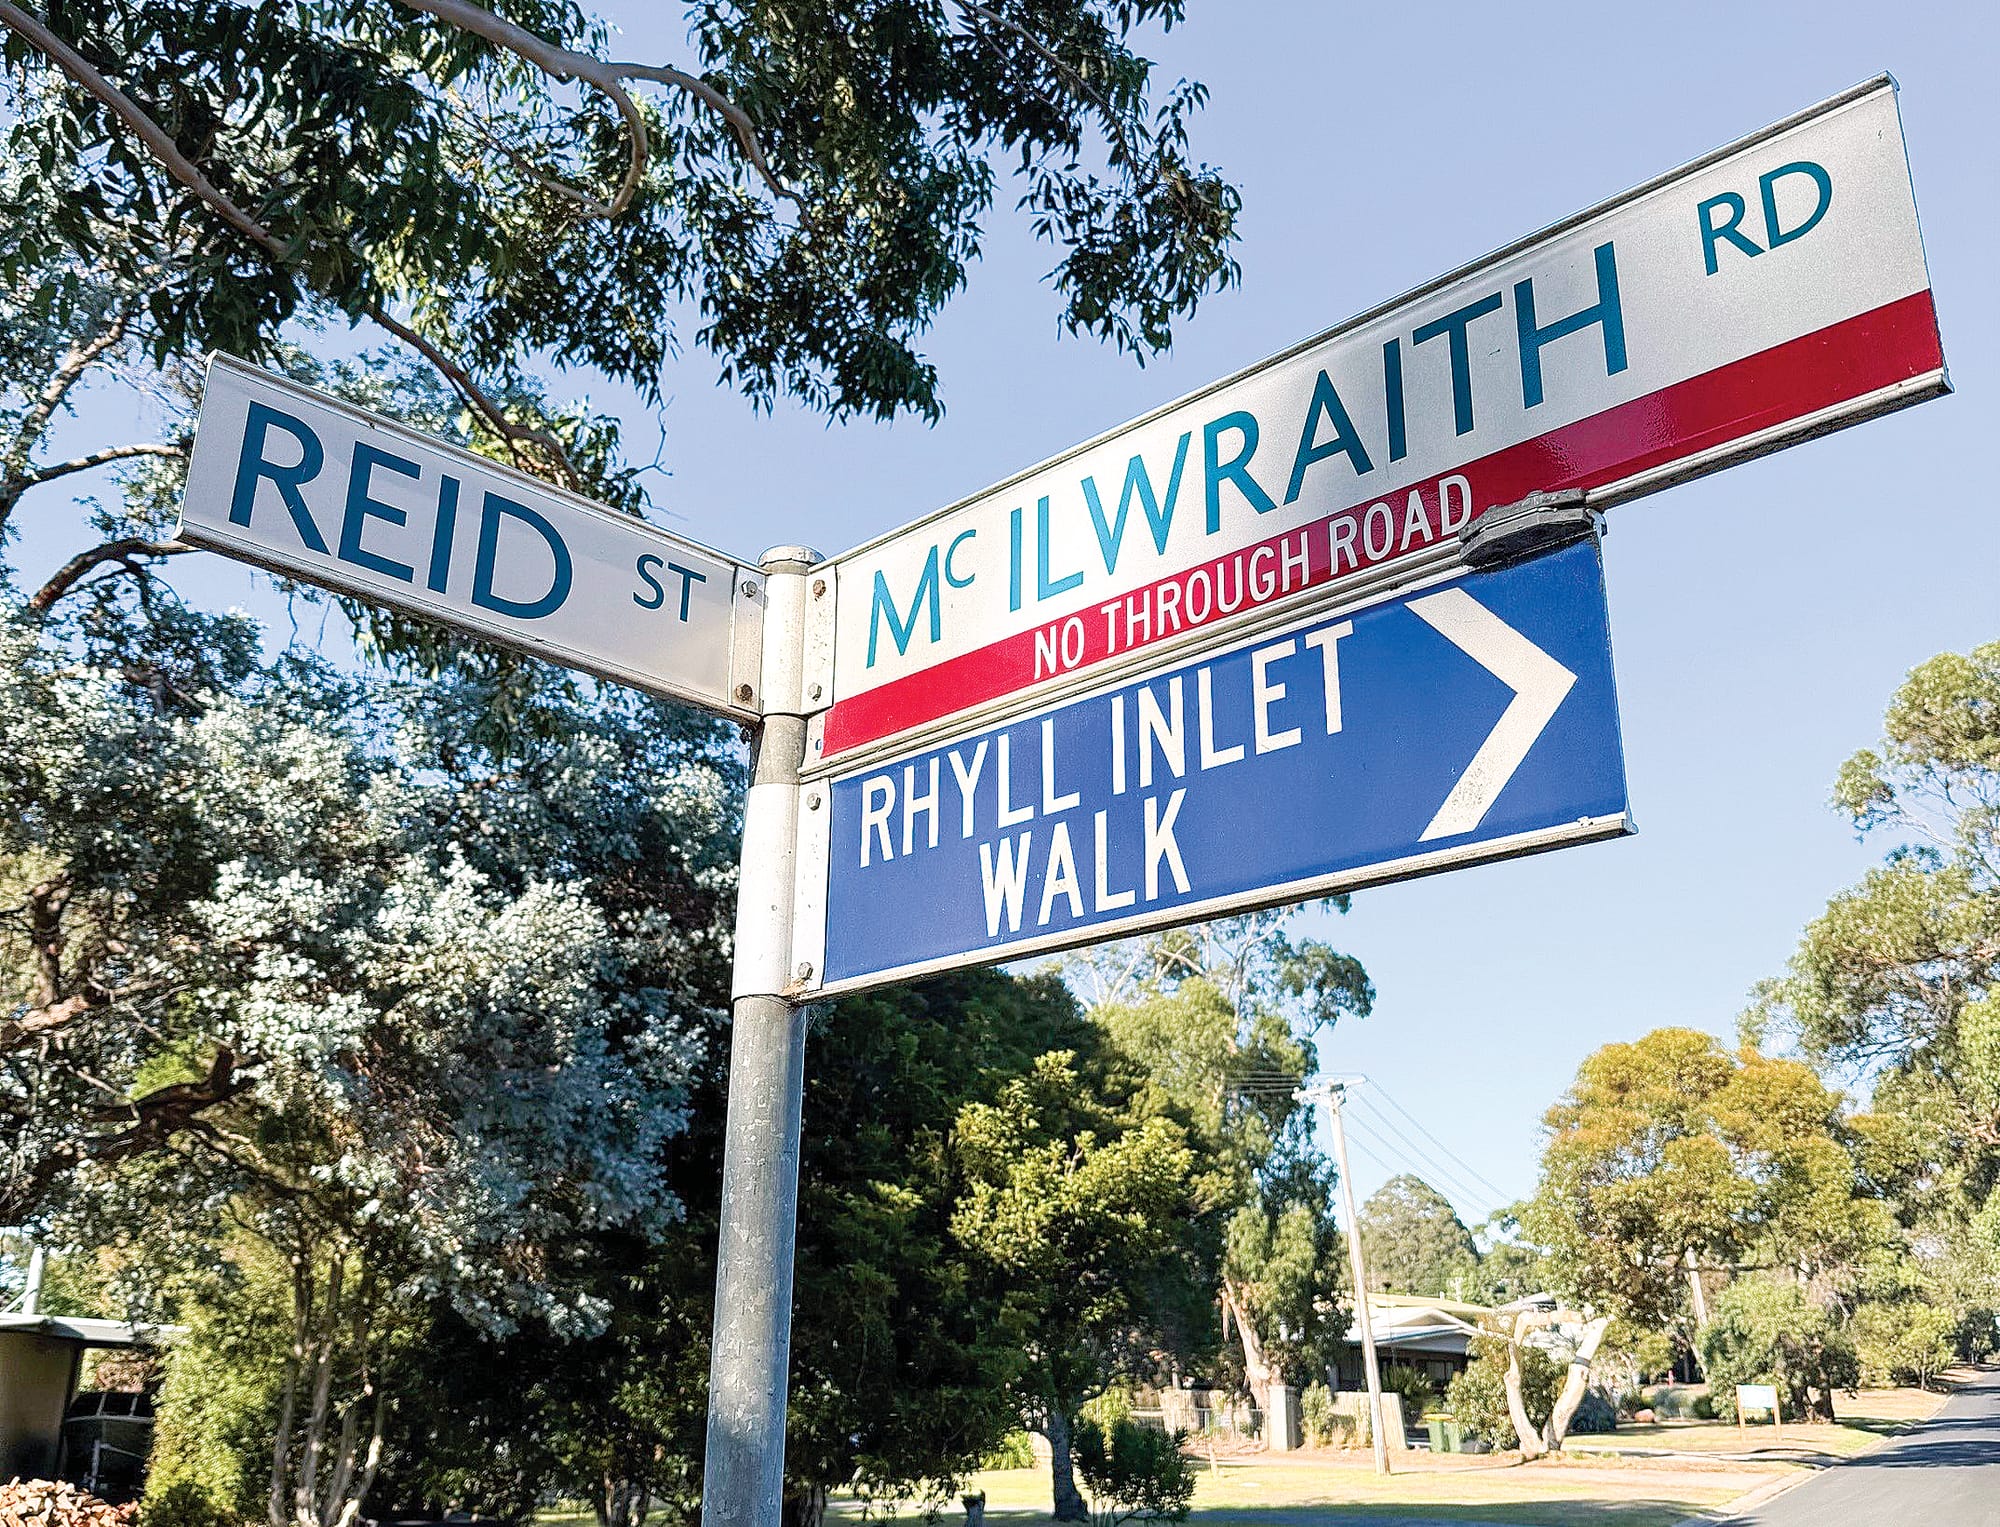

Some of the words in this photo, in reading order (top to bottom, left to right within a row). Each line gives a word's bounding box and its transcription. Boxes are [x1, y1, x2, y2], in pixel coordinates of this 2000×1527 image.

[1697, 161, 1832, 276] RD
[229, 401, 572, 619] REID
[632, 554, 706, 623] ST
[1034, 617, 1086, 679] NO
[1101, 536, 1310, 655] THROUGH
[1328, 475, 1473, 573] ROAD
[859, 718, 1081, 868] RHYLL
[1111, 620, 1355, 796] INLET
[979, 788, 1192, 937] WALK
